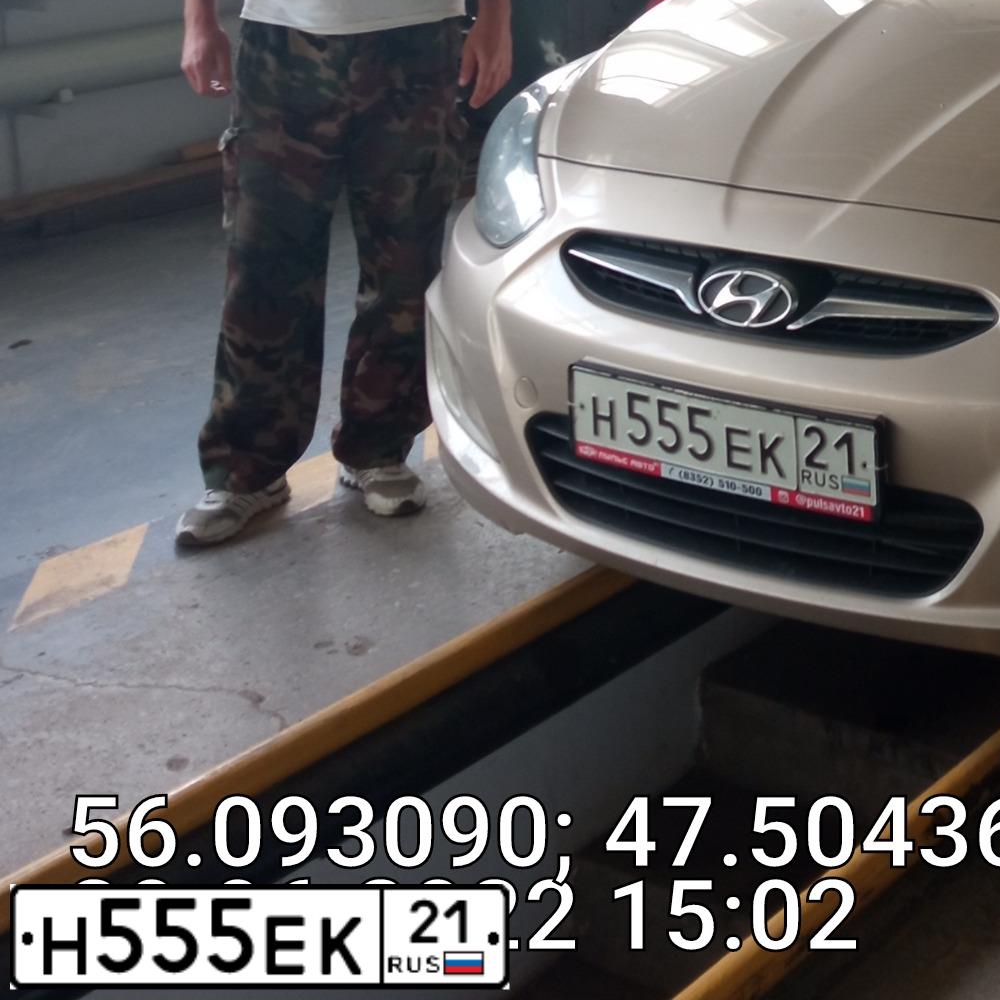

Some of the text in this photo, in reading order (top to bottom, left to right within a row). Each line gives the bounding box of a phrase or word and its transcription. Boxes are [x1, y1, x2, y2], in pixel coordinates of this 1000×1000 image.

[803, 426, 855, 475] 21
[678, 468, 714, 487] (8352)
[718, 479, 763, 497] 510-500
[801, 469, 840, 490] RUS
[795, 493, 865, 518] @pulsavto21
